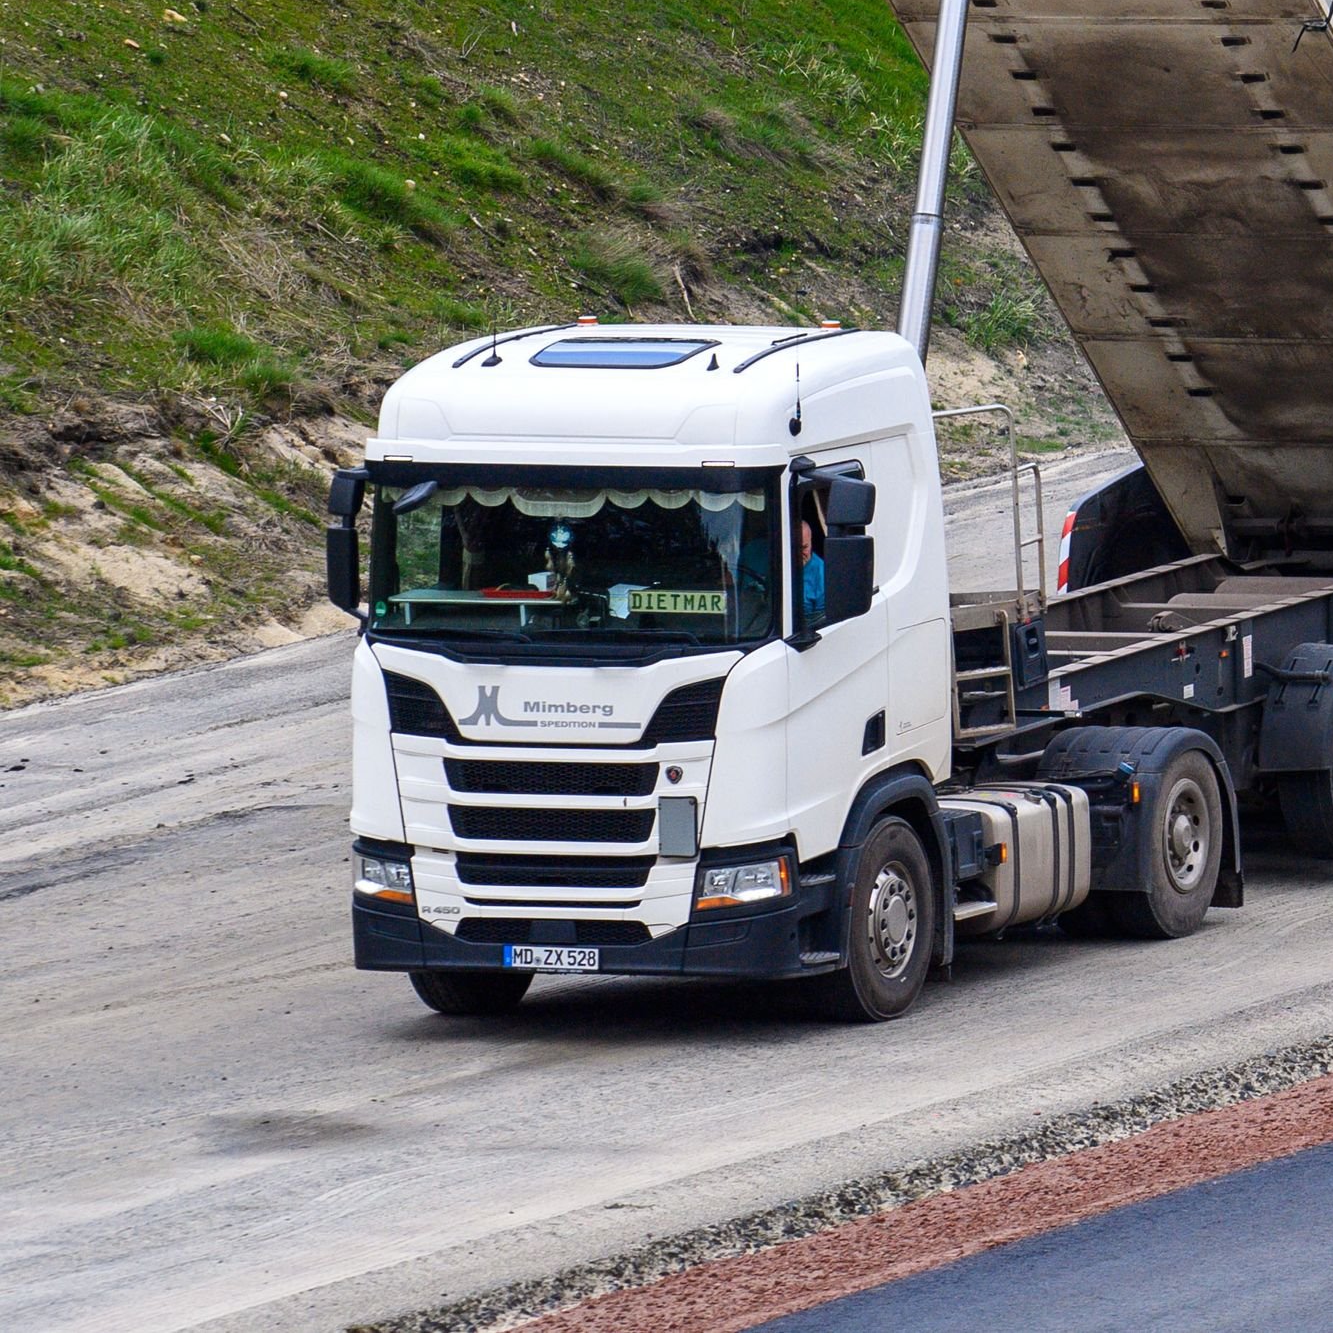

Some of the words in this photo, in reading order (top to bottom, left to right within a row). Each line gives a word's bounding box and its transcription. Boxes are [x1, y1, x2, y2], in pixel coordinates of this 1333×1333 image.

[631, 593, 722, 611] DIETMAR
[523, 701, 614, 717] Mimberg
[540, 720, 596, 728] SPEDITION
[422, 906, 431, 914] R
[433, 907, 460, 915] 450
[513, 948, 533, 965] MD
[543, 949, 564, 966] ZX
[567, 950, 596, 967] 528
